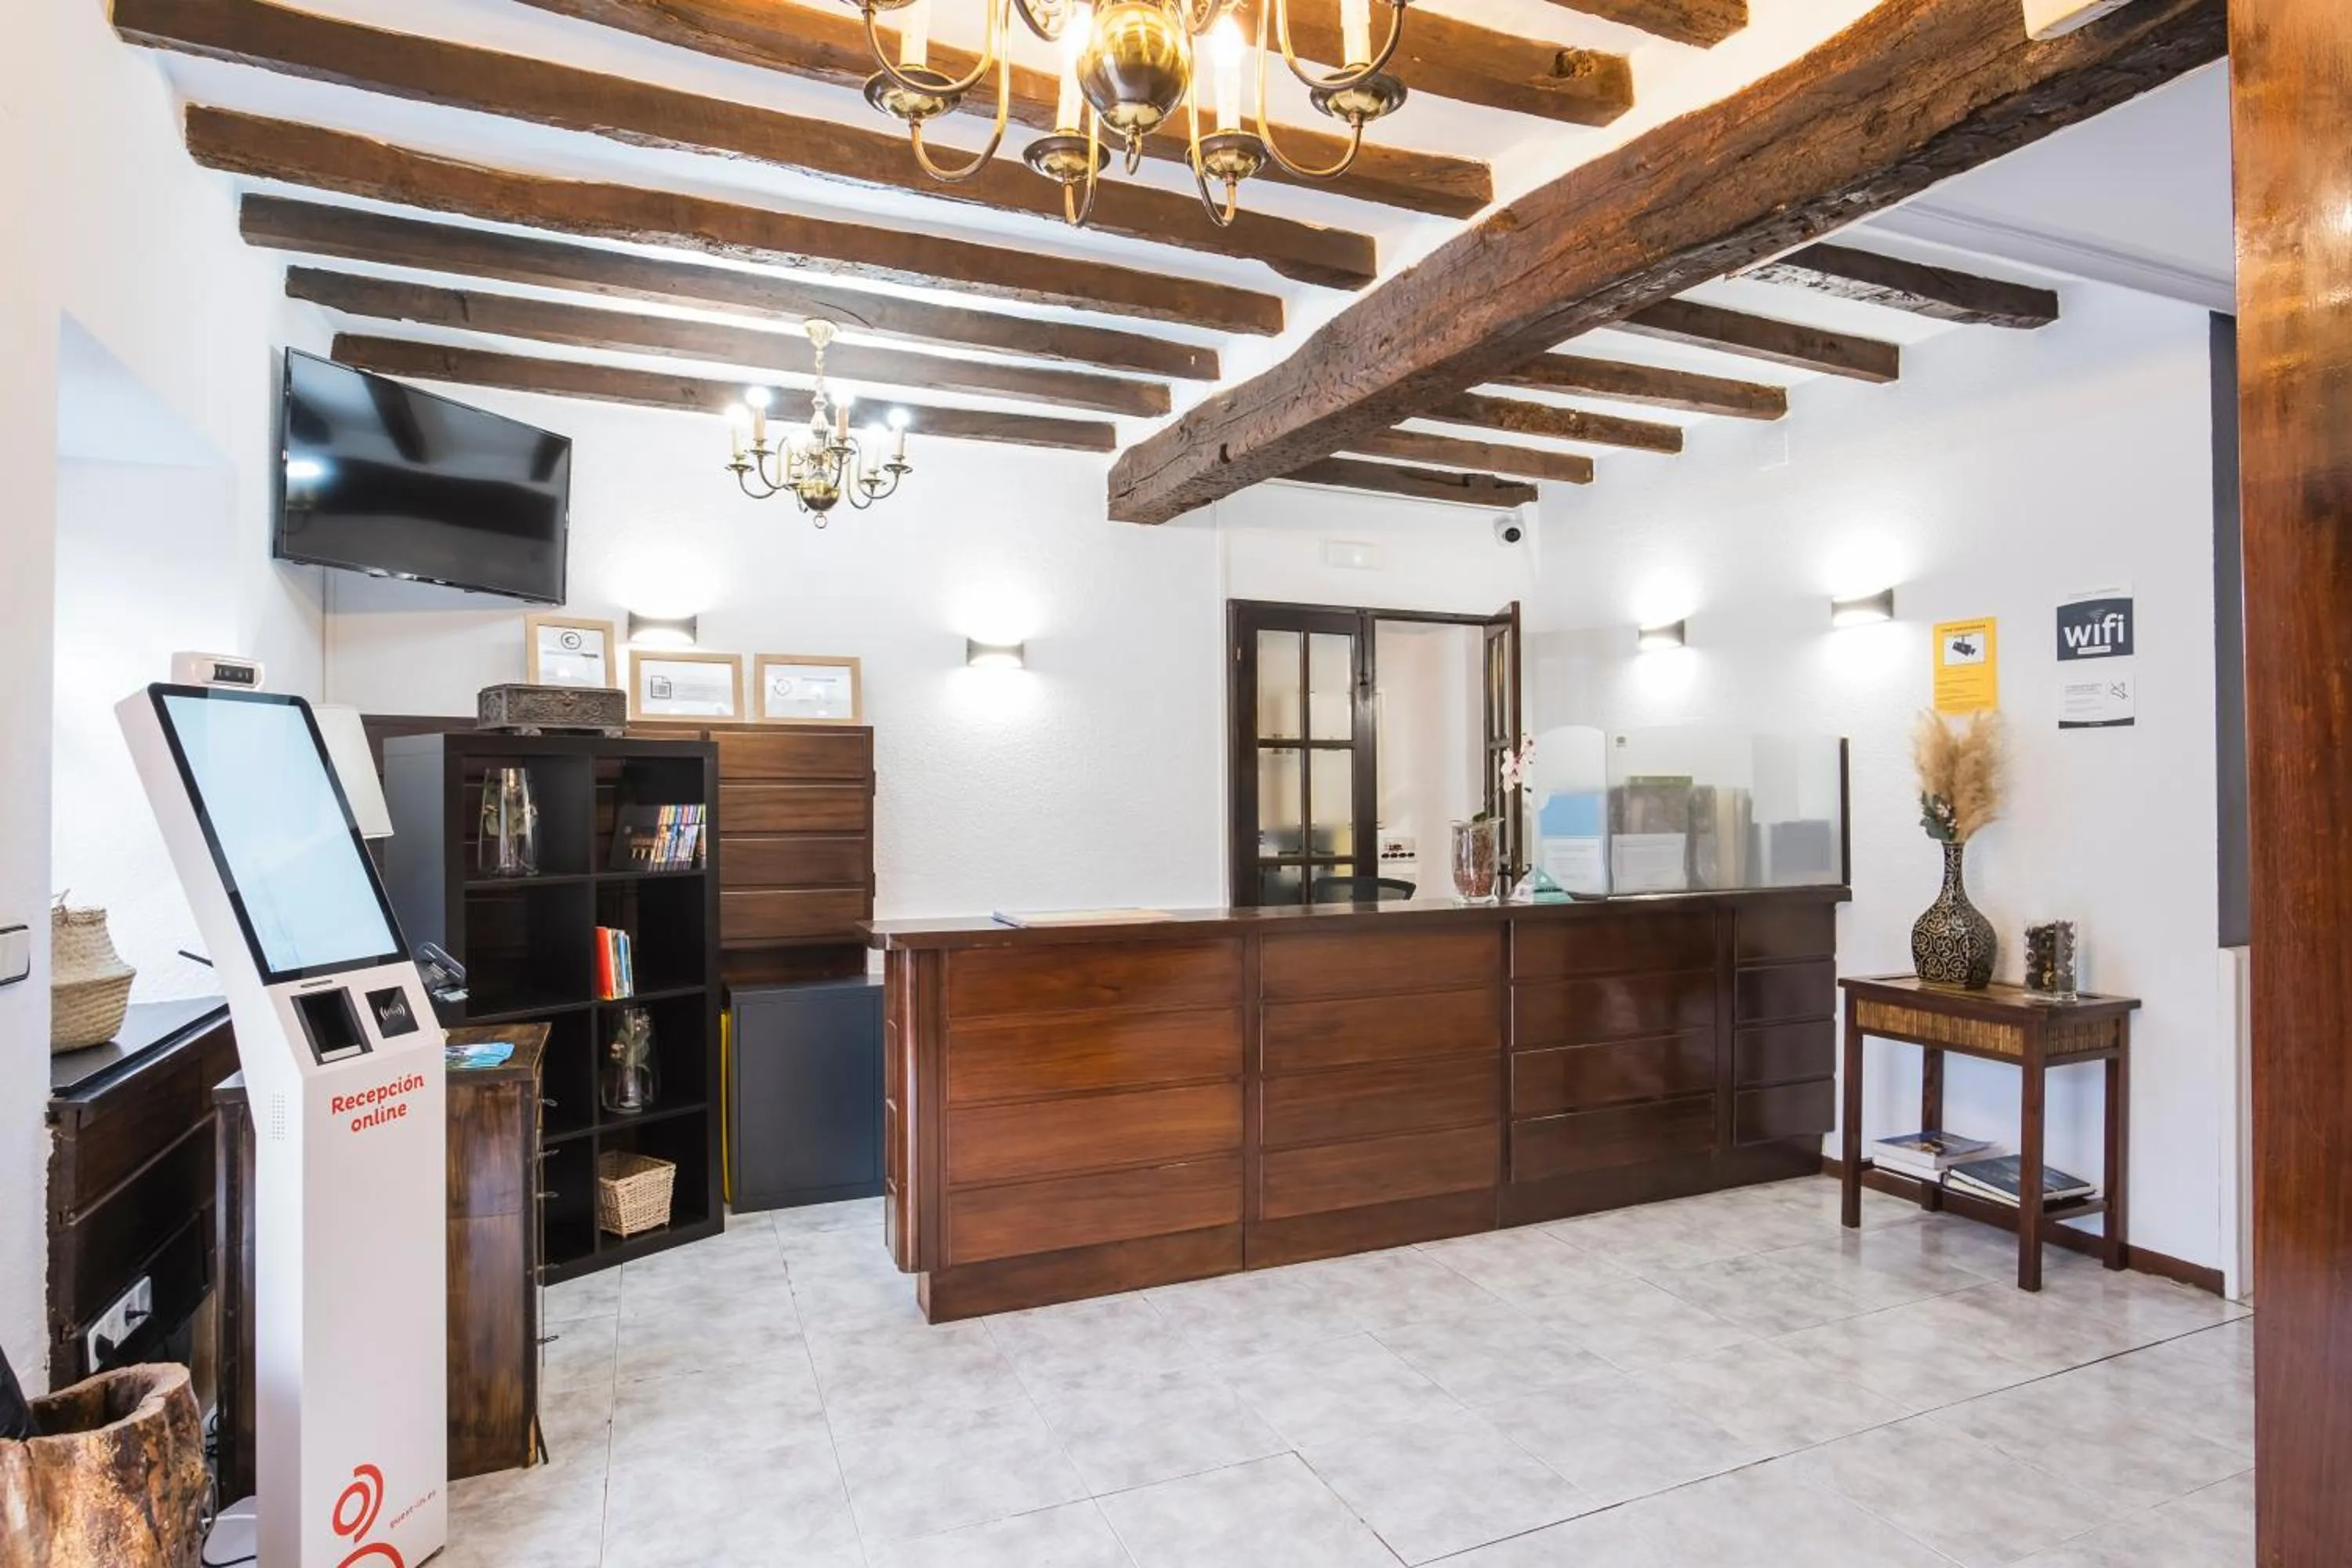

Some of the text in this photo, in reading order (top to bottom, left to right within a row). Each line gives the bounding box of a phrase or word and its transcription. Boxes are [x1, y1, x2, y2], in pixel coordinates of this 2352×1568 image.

[2063, 613, 2124, 648] wifi
[332, 1073, 424, 1114] Recepción
[350, 1103, 407, 1131] online
